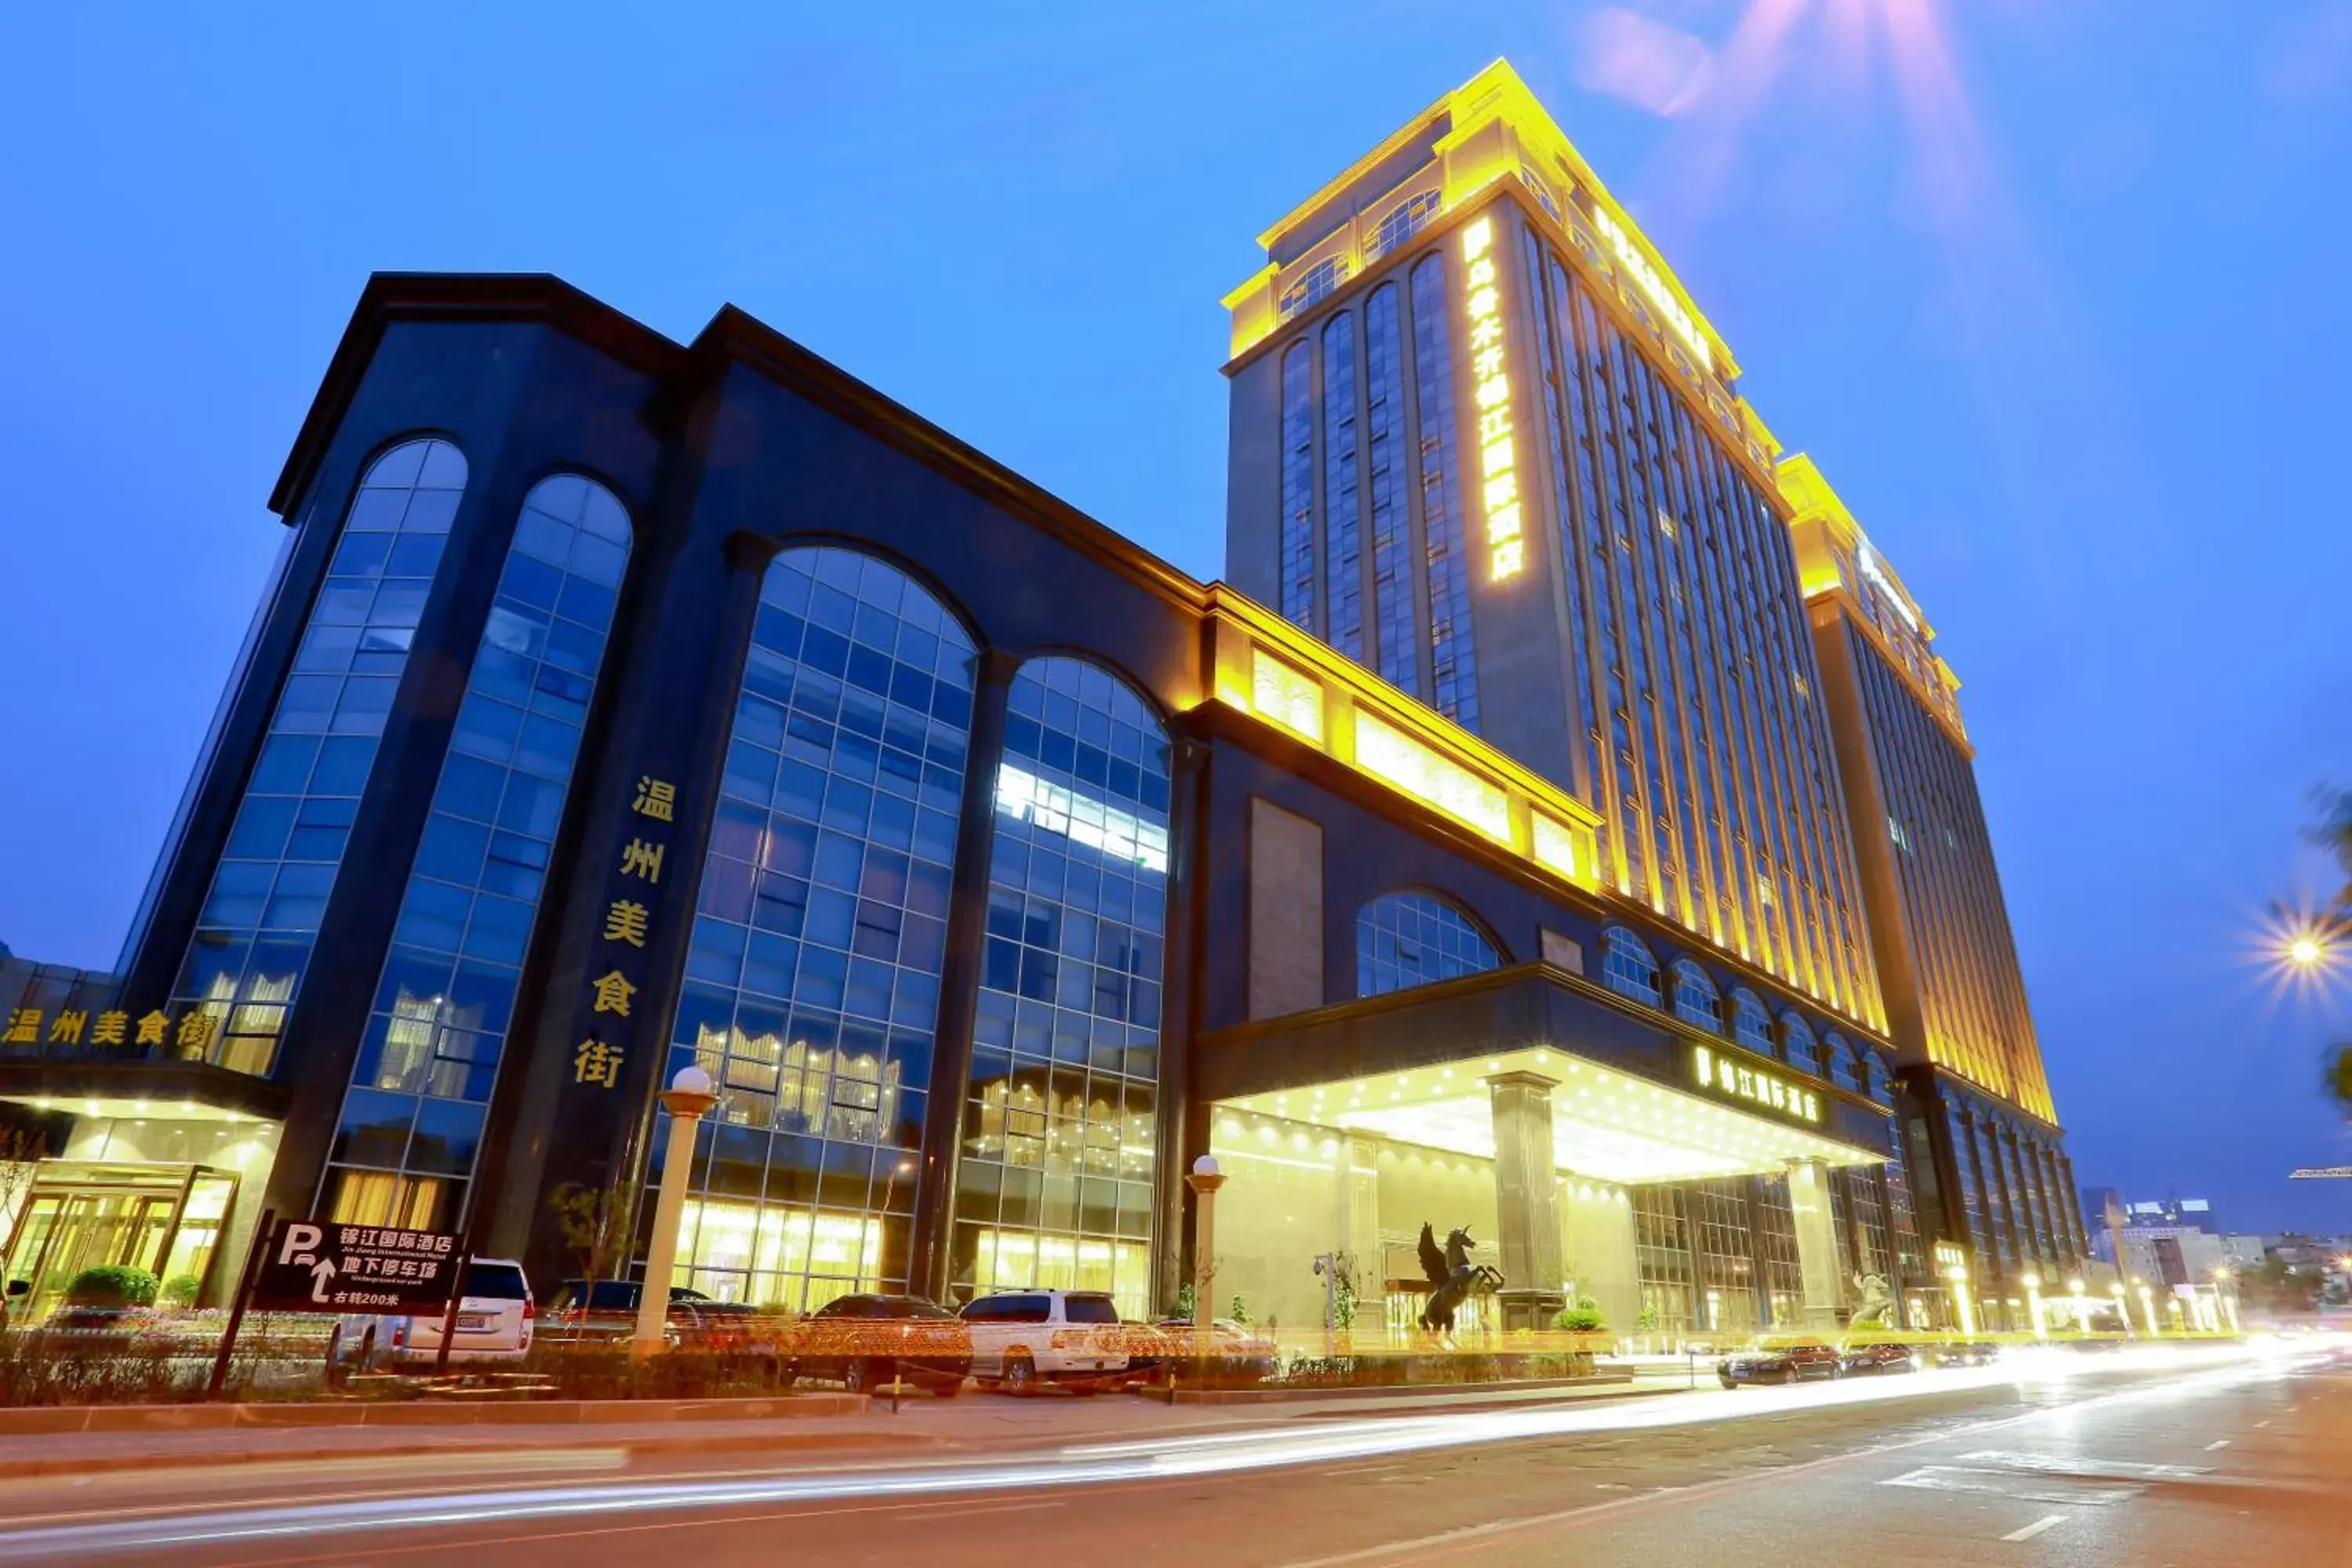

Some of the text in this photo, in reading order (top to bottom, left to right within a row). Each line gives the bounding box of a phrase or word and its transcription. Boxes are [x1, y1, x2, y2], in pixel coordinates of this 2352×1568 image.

[575, 775, 678, 1089] 温州美食街
[0, 1007, 217, 1047] 温州美食街
[278, 1223, 322, 1265] P
[339, 1227, 453, 1252] 锦江国际酒店
[340, 1256, 438, 1279] 地下停车场
[333, 1290, 399, 1306] 右转200米
